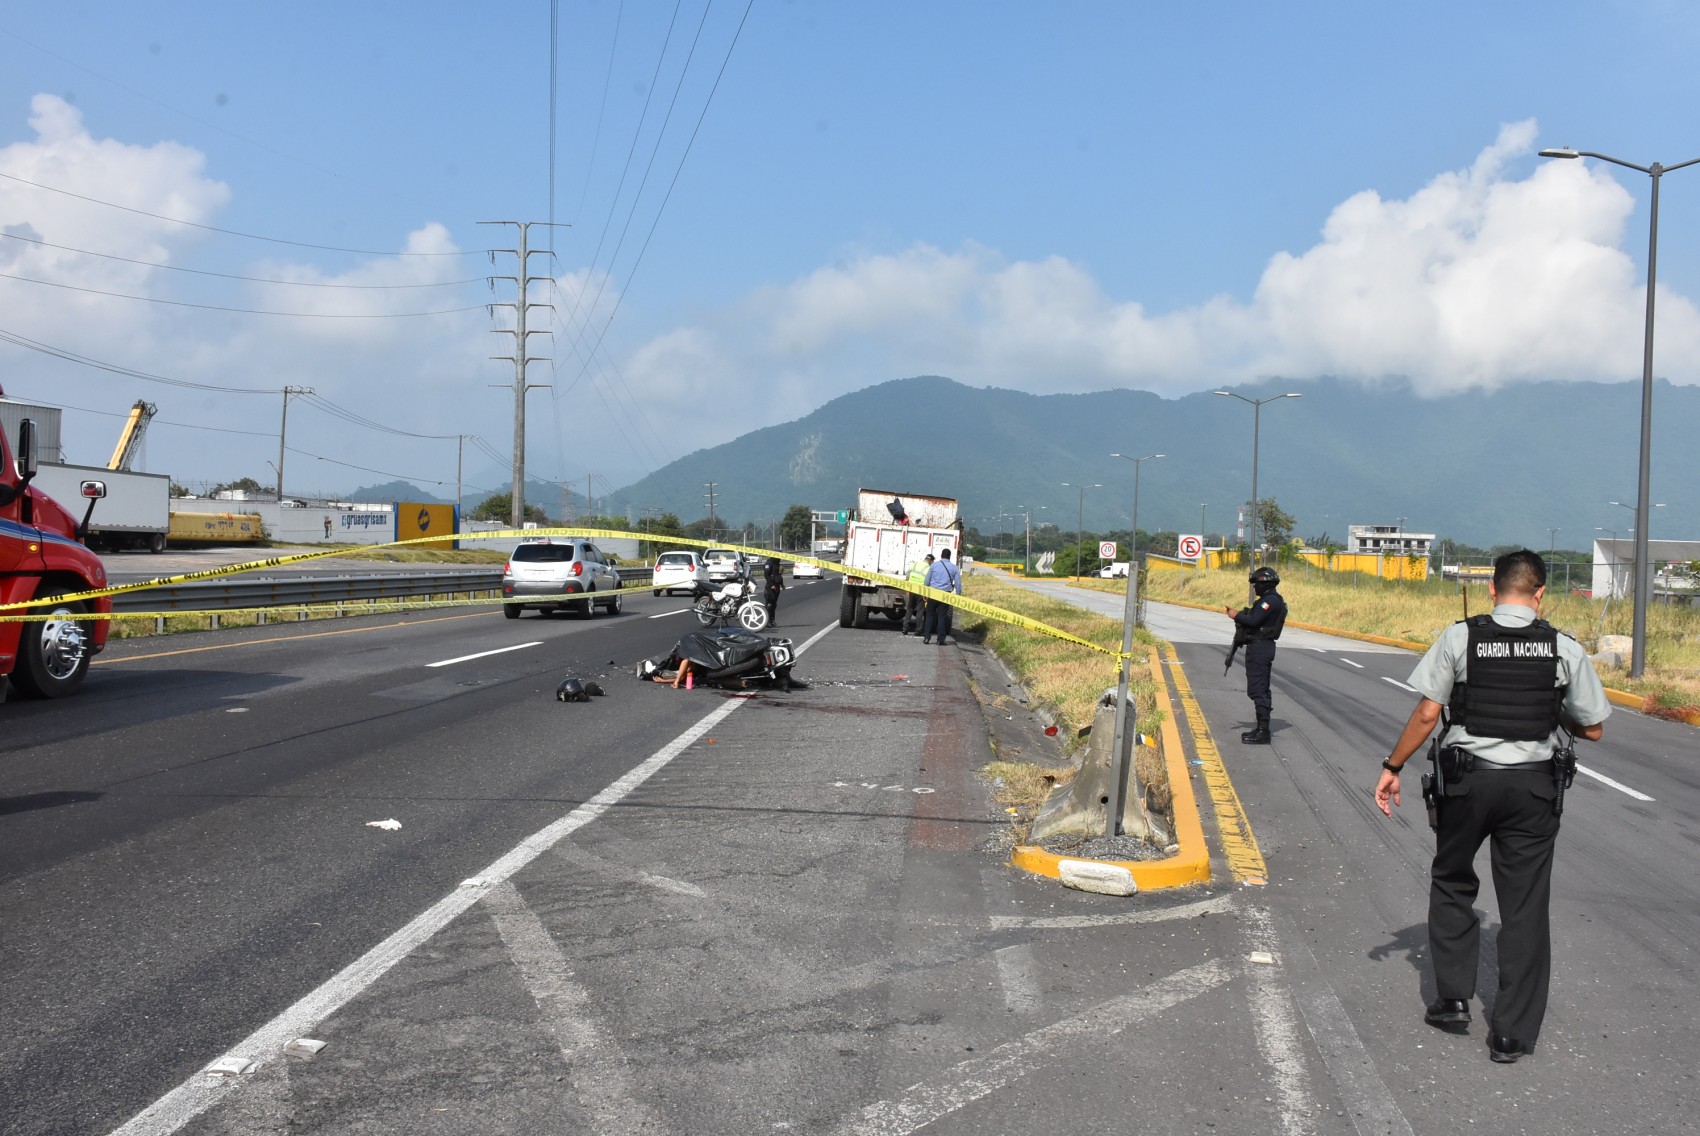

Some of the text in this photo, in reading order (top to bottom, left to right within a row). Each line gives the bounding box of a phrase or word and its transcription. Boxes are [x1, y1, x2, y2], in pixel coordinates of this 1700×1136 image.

[1104, 545, 1112, 553] 20
[1477, 642, 1554, 658] GUARDIA NACIONAL
